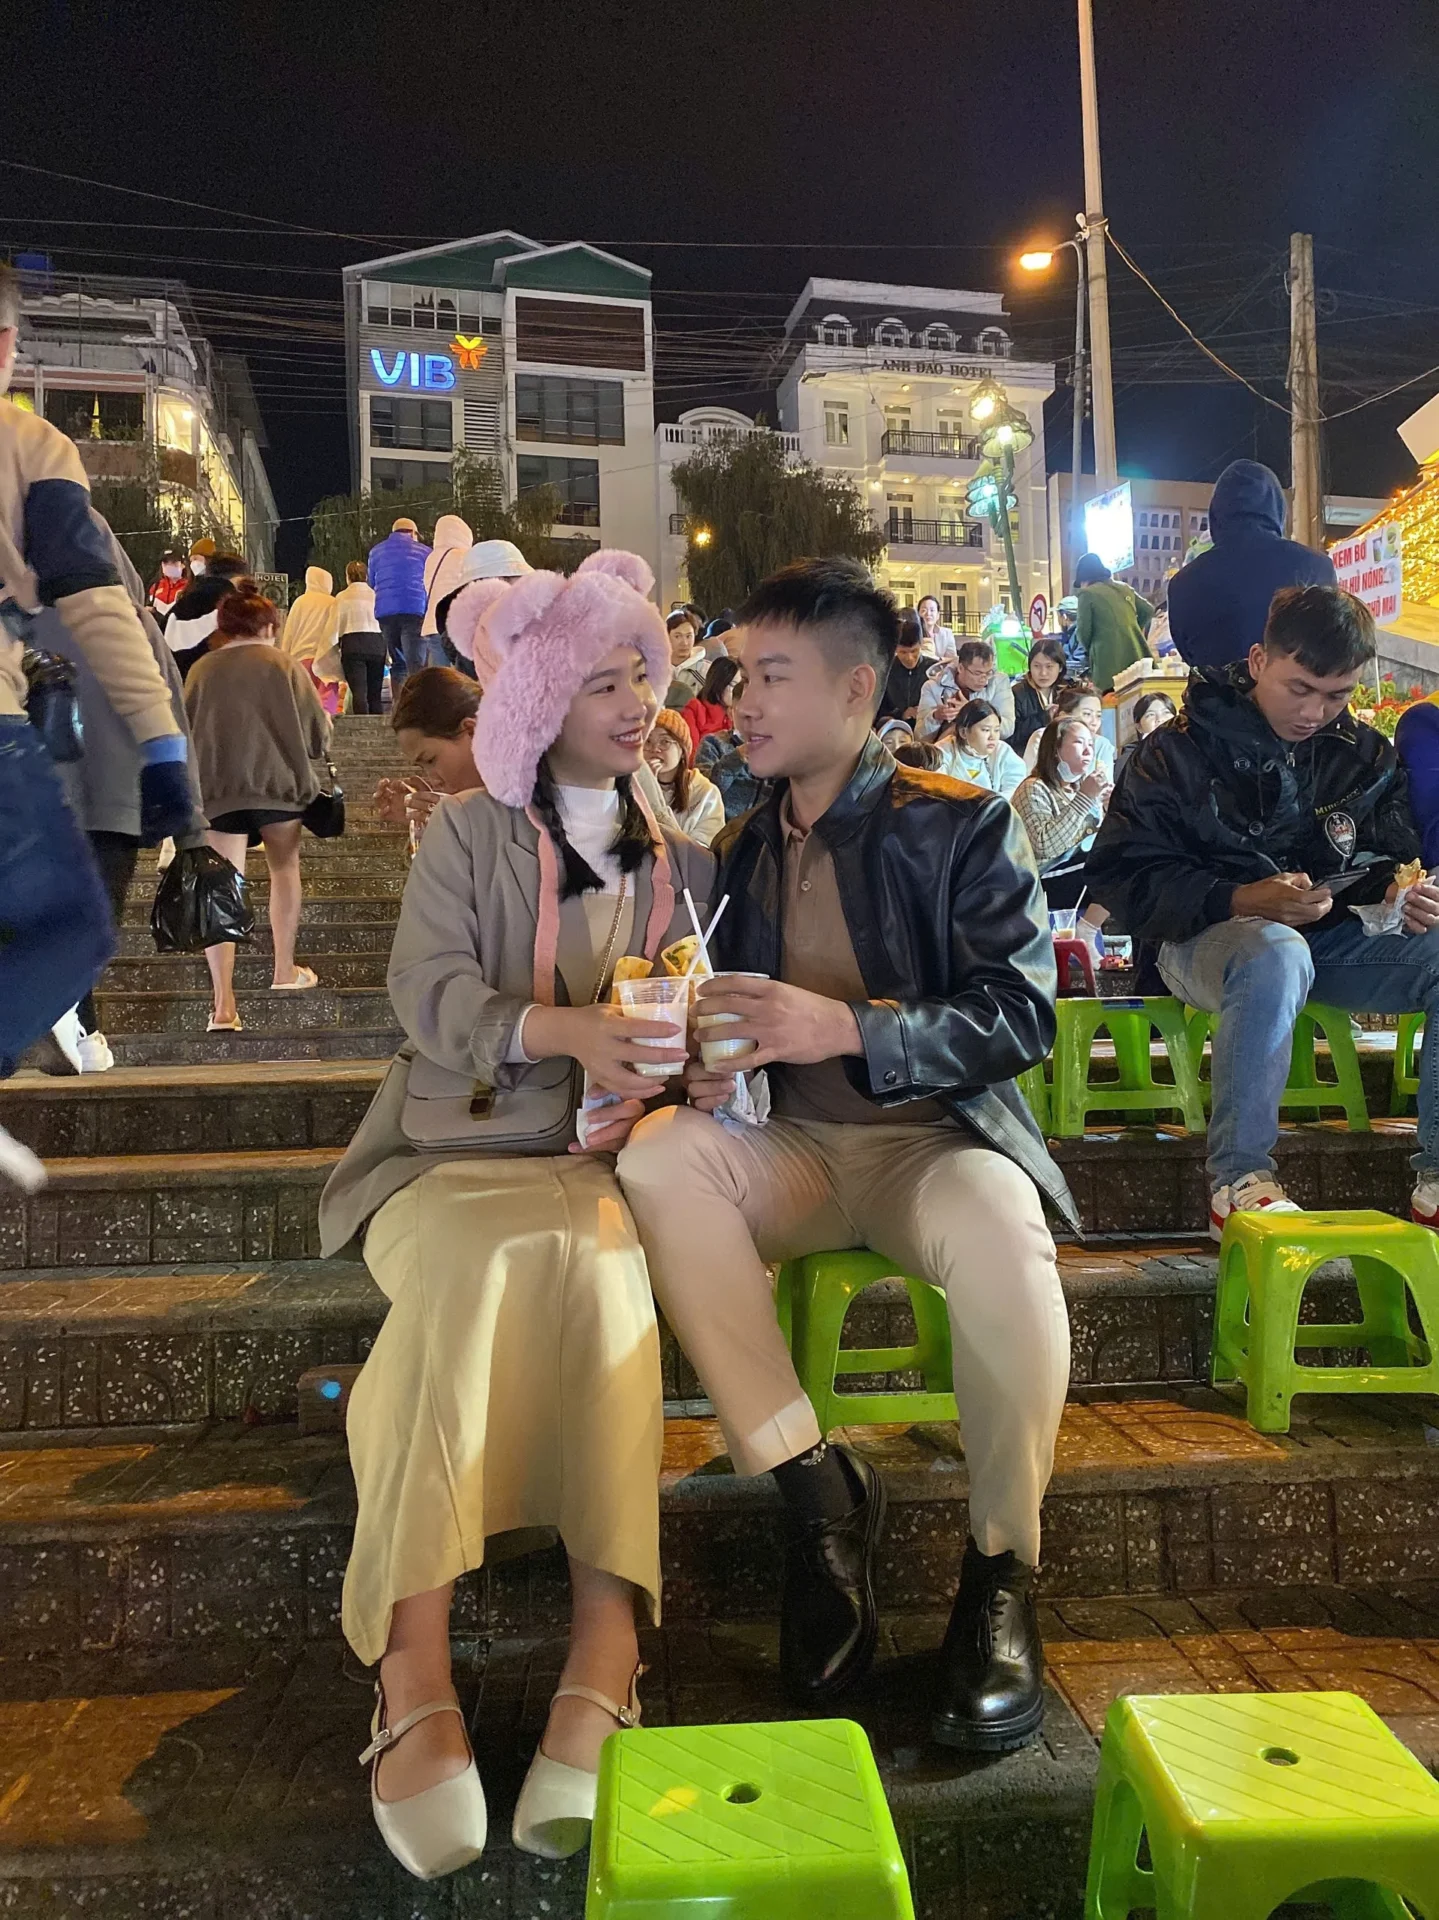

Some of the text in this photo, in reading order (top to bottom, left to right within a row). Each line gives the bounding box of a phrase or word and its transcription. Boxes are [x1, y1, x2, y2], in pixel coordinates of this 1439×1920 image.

[370, 349, 455, 389] VIB
[950, 365, 995, 379] HOTEL
[1332, 547, 1352, 569] KEM
[257, 574, 285, 583] HOTEL
